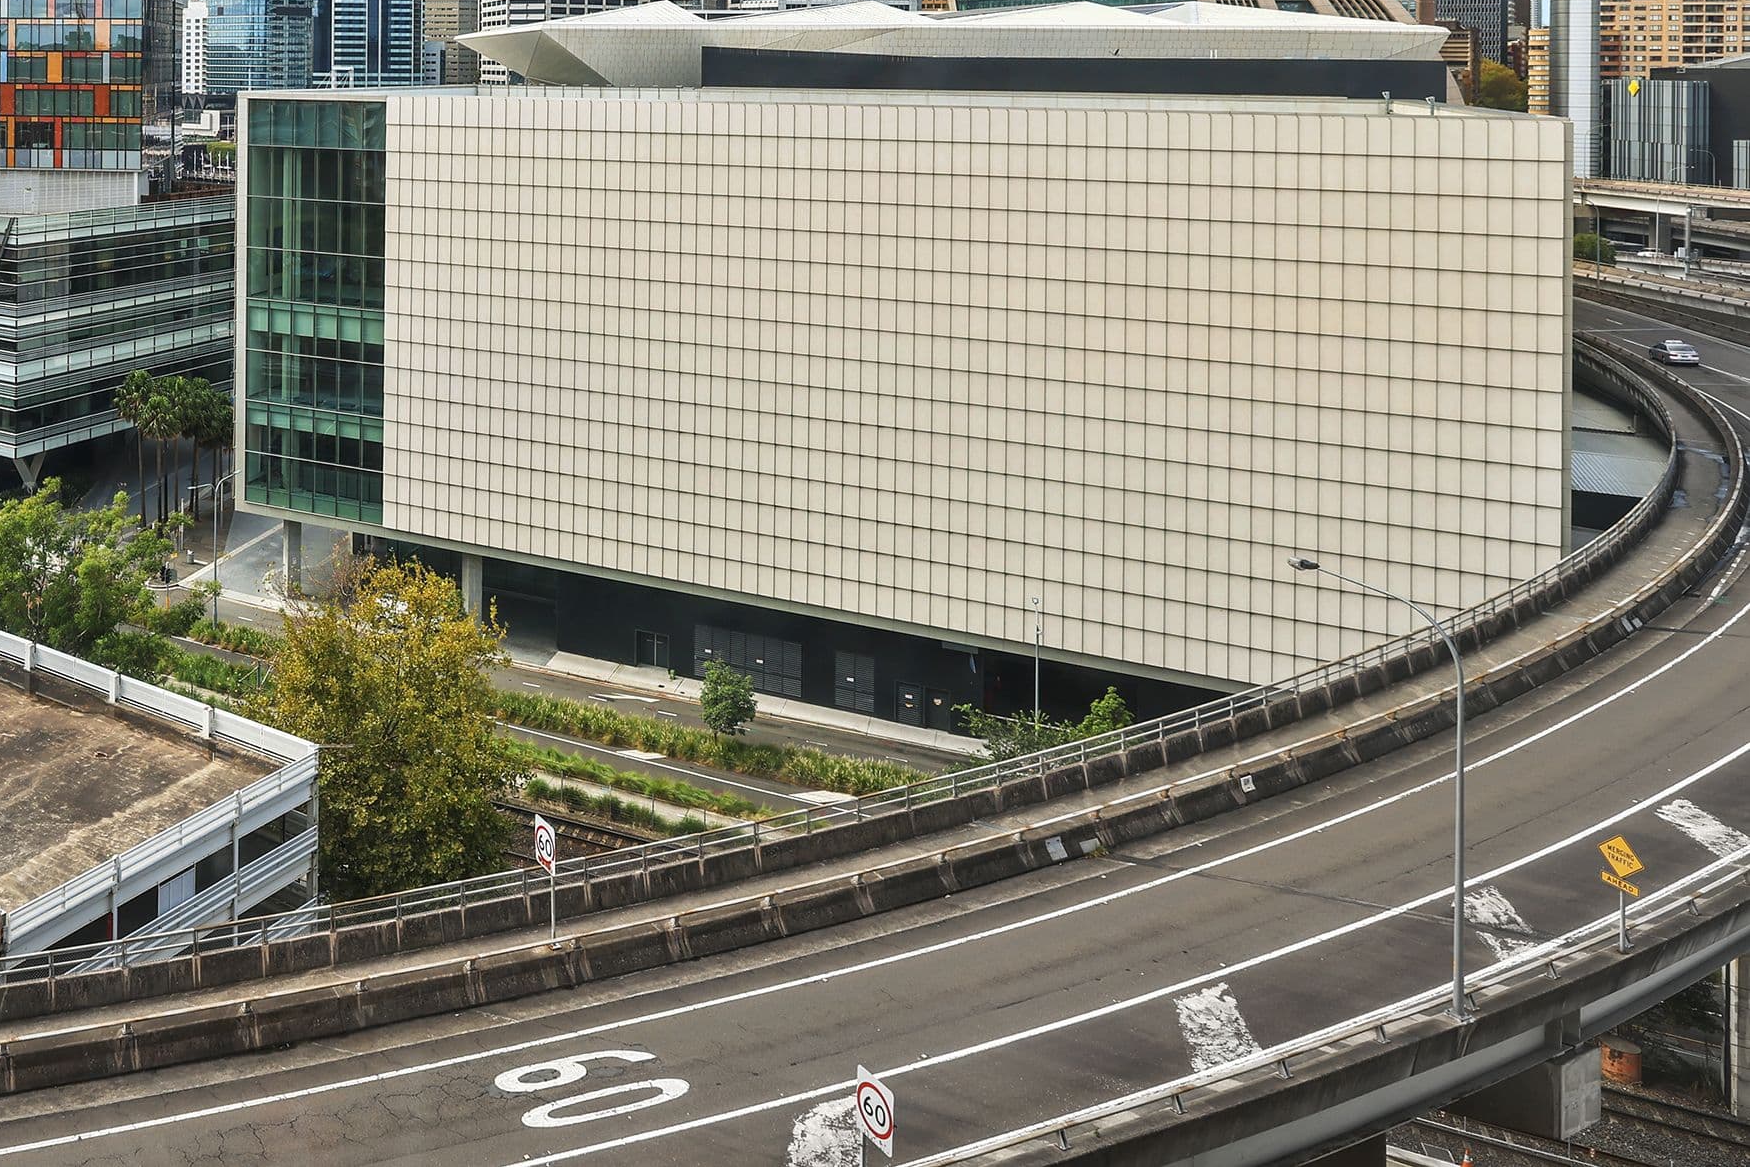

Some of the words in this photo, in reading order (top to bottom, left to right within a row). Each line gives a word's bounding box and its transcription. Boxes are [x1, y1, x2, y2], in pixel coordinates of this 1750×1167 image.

[538, 834, 552, 858] 60
[1607, 844, 1635, 862] MERGING
[1607, 852, 1634, 869] TRAFFIC
[1606, 875, 1634, 893] AHEAD
[494, 1049, 691, 1128] 60
[863, 1095, 886, 1127] 60
